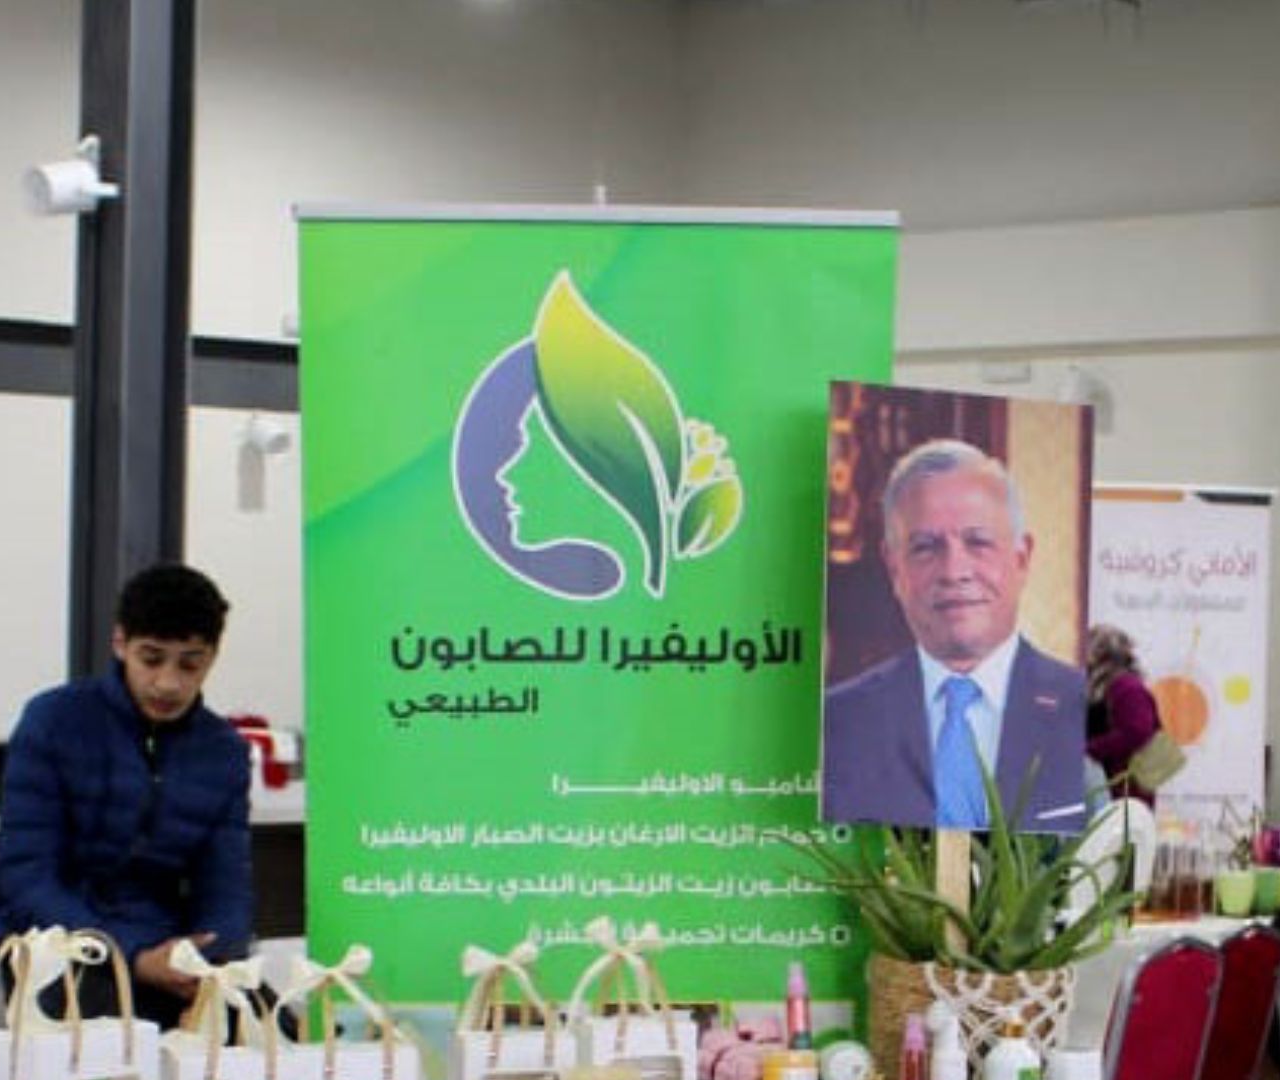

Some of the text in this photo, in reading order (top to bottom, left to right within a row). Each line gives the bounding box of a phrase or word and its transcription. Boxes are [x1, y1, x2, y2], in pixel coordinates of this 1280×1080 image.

[391, 621, 801, 671] الأوليفيرا للصابون
[388, 686, 540, 727] الطبيعي
[418, 869, 494, 897] بكافة
[497, 871, 576, 904] البلدي
[579, 870, 671, 898] الزيتون
[676, 873, 734, 898] زيت
[728, 920, 826, 948] كريمات
